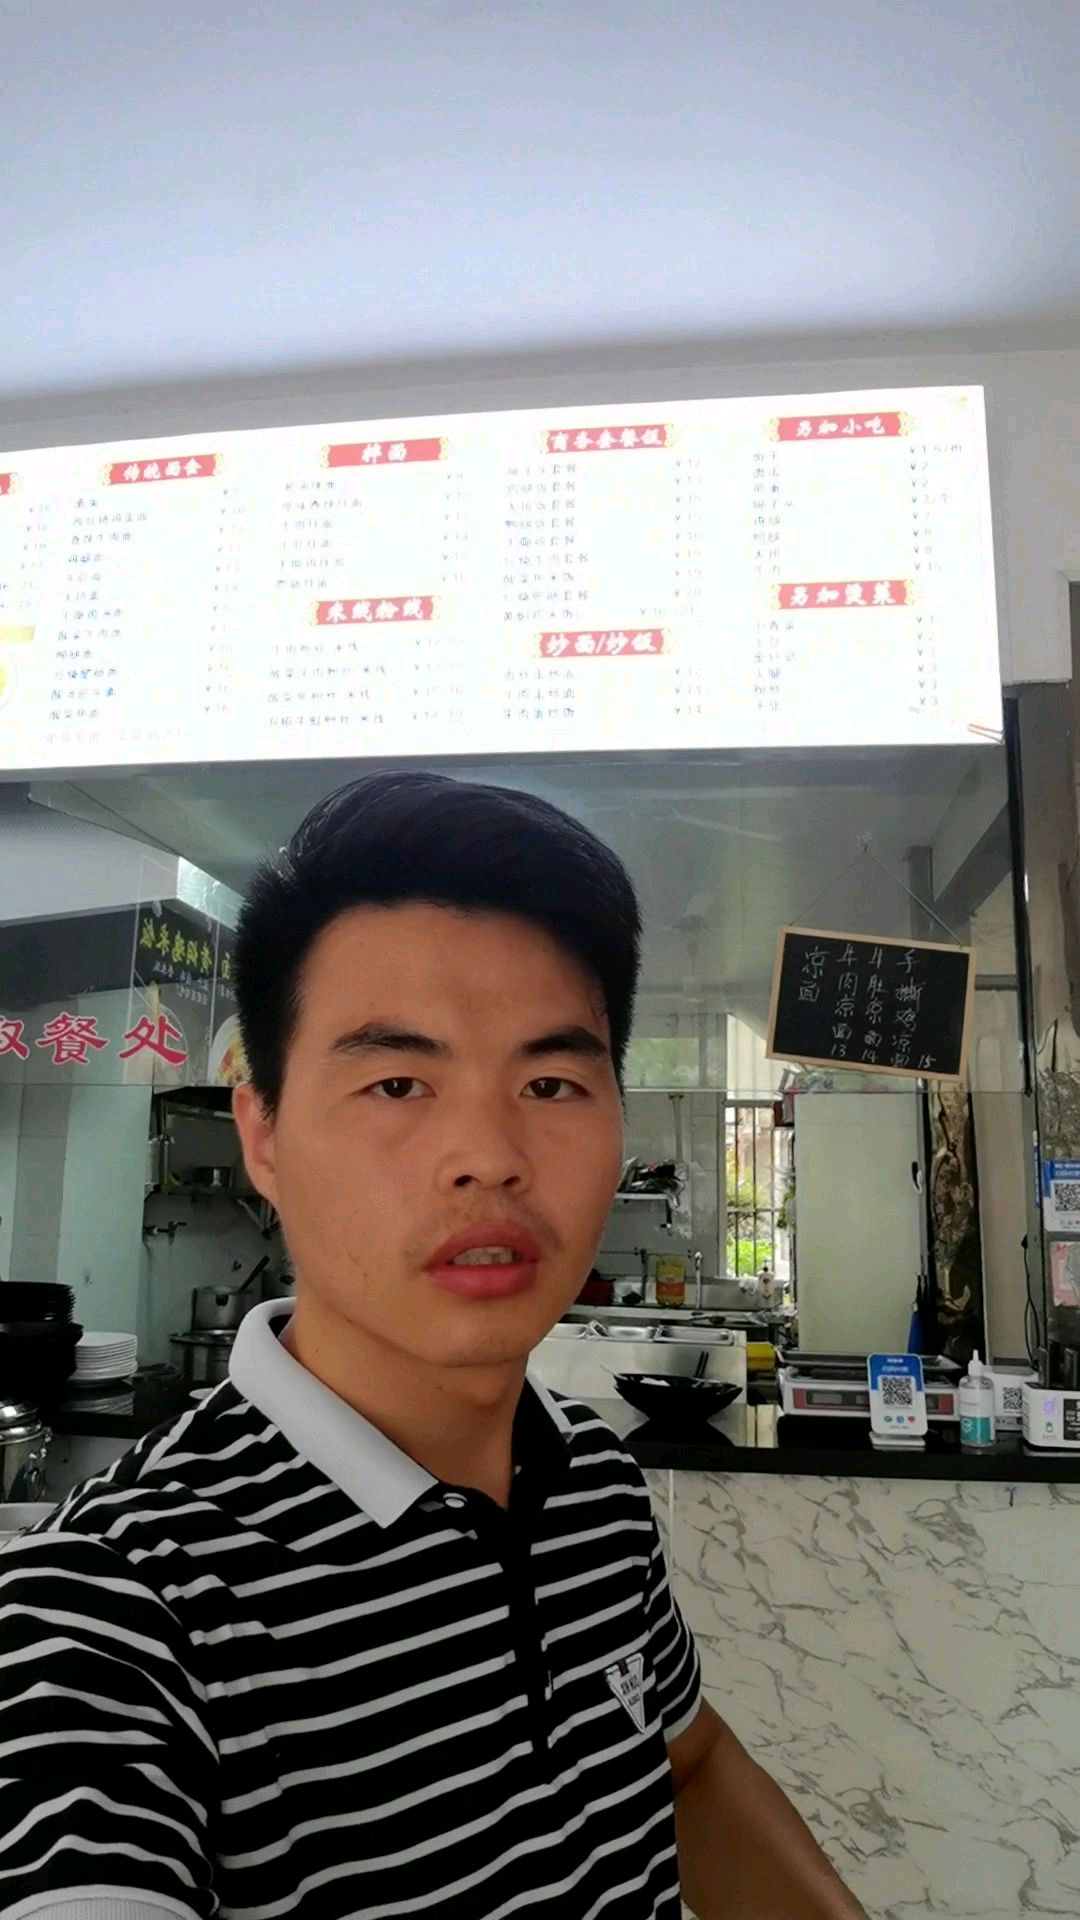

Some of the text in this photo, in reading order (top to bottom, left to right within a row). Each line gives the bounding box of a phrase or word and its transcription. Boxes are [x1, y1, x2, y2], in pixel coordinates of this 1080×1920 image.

[798, 945, 831, 1002] 凉面
[831, 1044, 847, 1057] 13
[861, 1049, 878, 1064] 14
